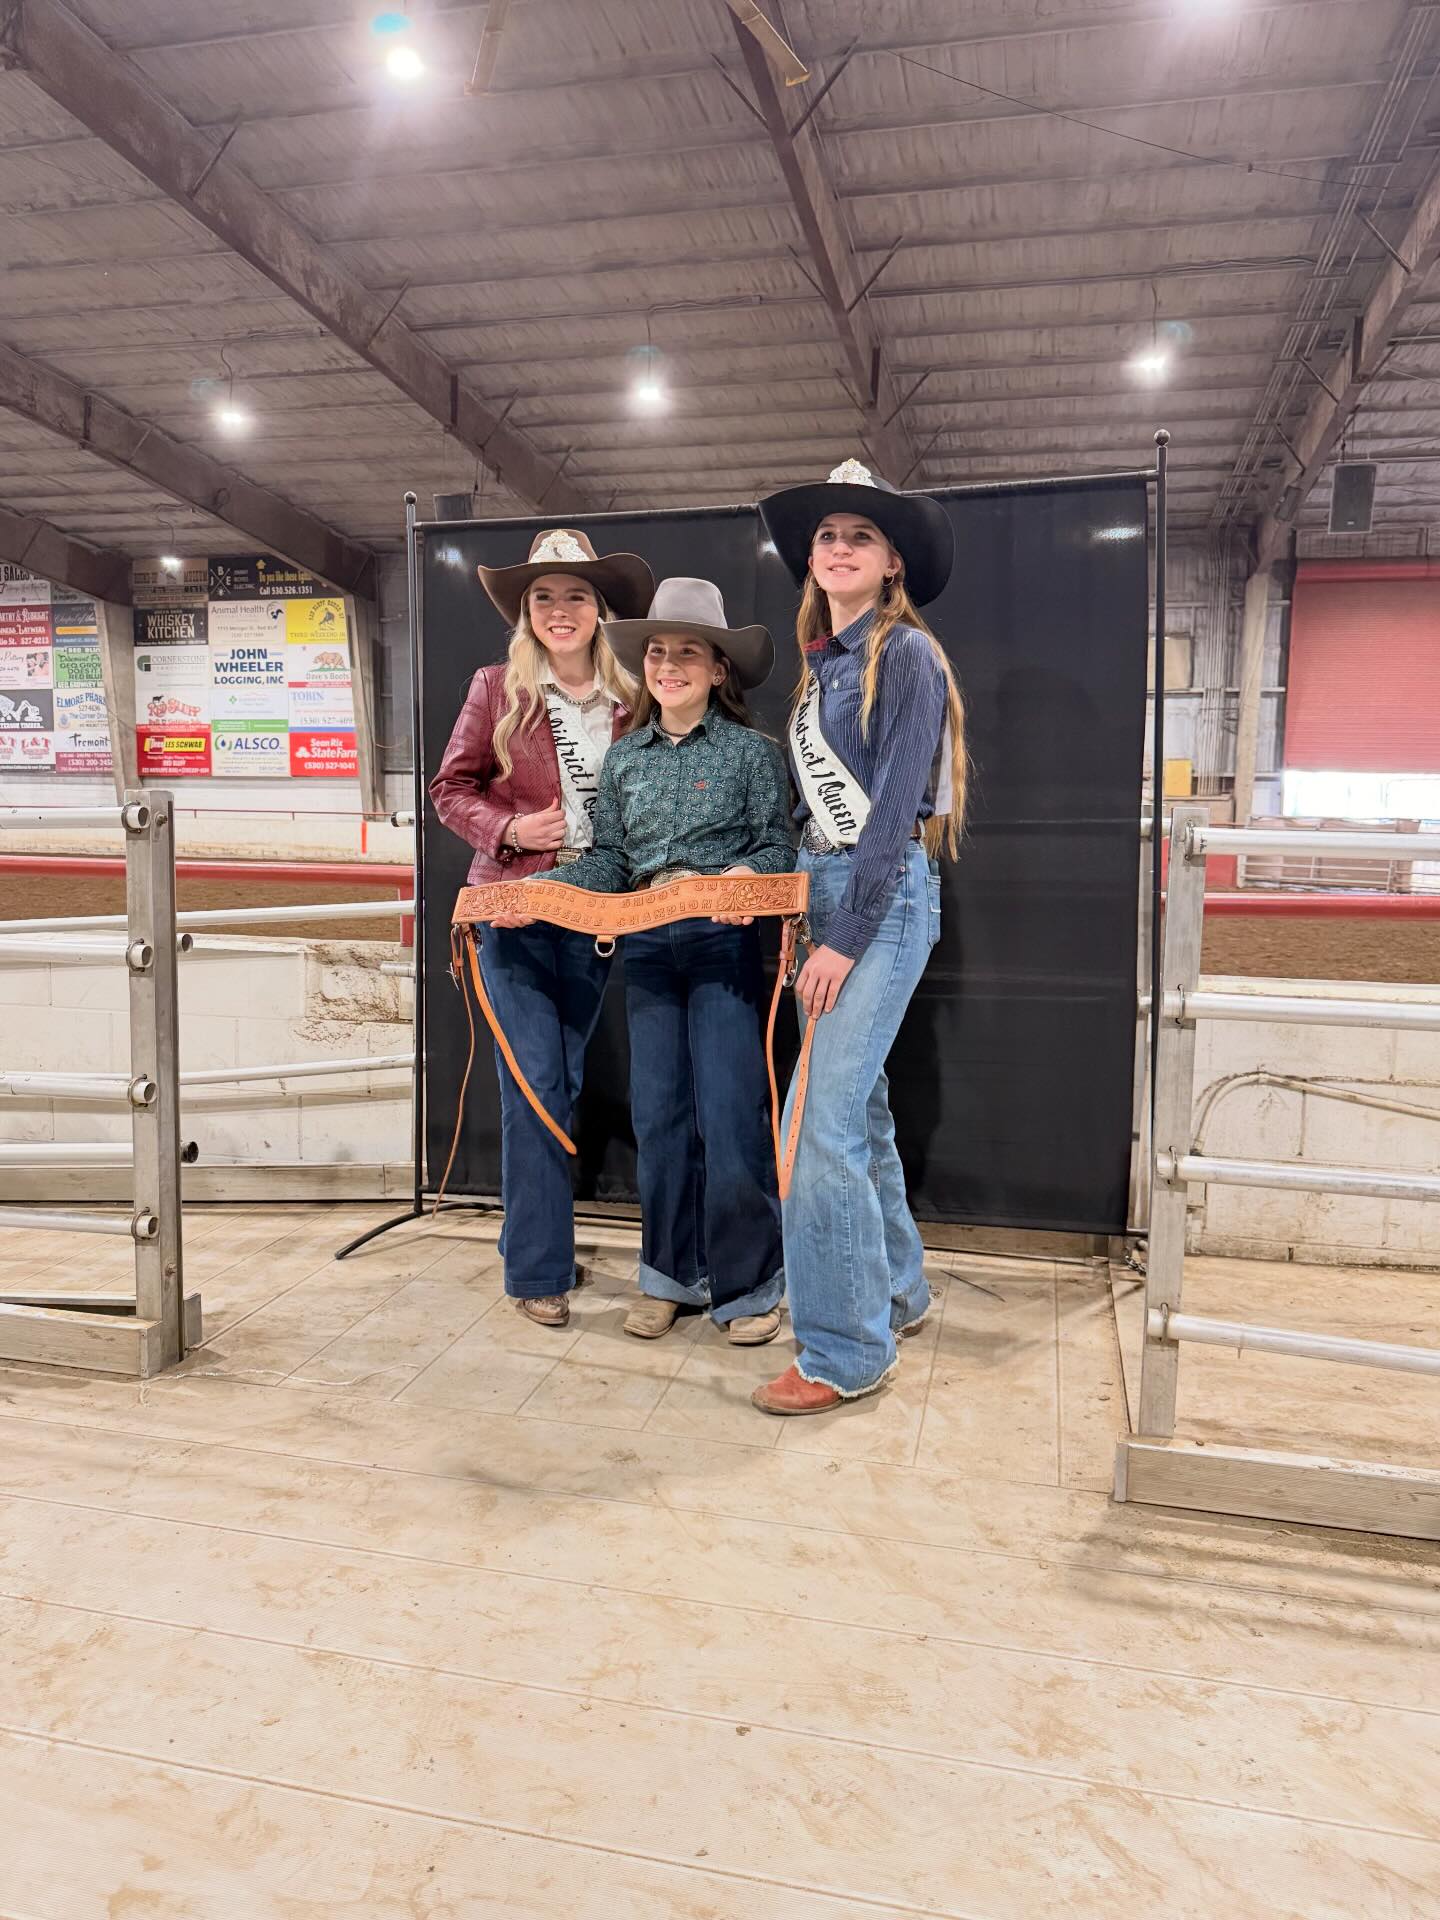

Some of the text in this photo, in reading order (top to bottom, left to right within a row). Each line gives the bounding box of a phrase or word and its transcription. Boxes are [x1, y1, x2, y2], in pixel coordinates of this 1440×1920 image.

[259, 586, 313, 595] Call 530.526.1351
[211, 605, 238, 614] Animal
[240, 605, 264, 614] Health
[148, 614, 194, 626] WHISKEY
[148, 626, 194, 639] KITCHEN
[151, 655, 207, 664] CORNERSTONE
[229, 649, 267, 660] JOHN
[214, 661, 284, 673] WHEELER
[214, 676, 284, 685] LOGGING, INC
[57, 695, 83, 708] ELMORE
[68, 733, 112, 747] Tremont
[234, 738, 280, 750] ALSCO
[795, 700, 825, 772] District
[811, 771, 836, 779] 1
[622, 885, 680, 909] SHOOT
[695, 880, 730, 892] OUT
[530, 898, 713, 927] RESERVE CHAMPION
